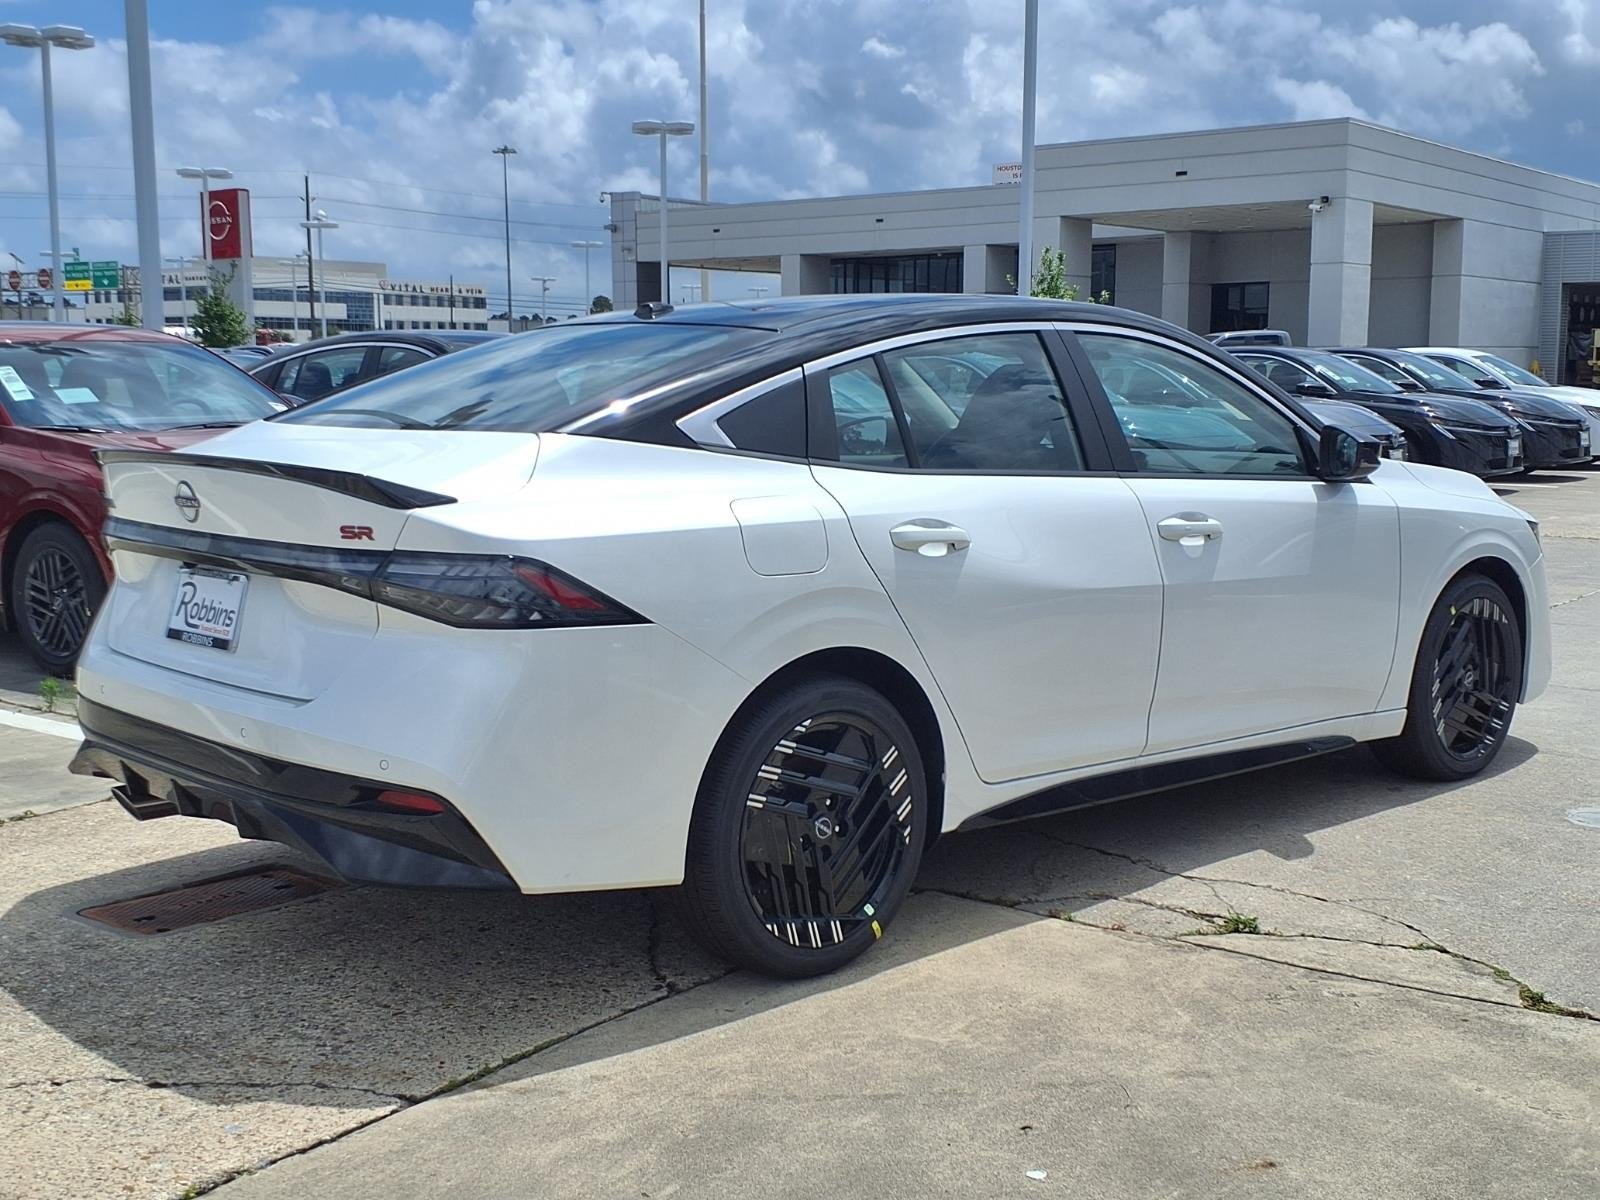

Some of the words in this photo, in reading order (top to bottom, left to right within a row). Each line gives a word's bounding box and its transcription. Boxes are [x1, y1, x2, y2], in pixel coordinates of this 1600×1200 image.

[997, 164, 1022, 172] HOUSTO
[210, 216, 233, 225] SSAN
[161, 274, 182, 285] TAL
[390, 283, 425, 293] VITAL
[430, 286, 454, 294] HEAR
[340, 525, 375, 541] SR
[176, 581, 236, 629] Robbins
[182, 632, 214, 647] ROBBINS
